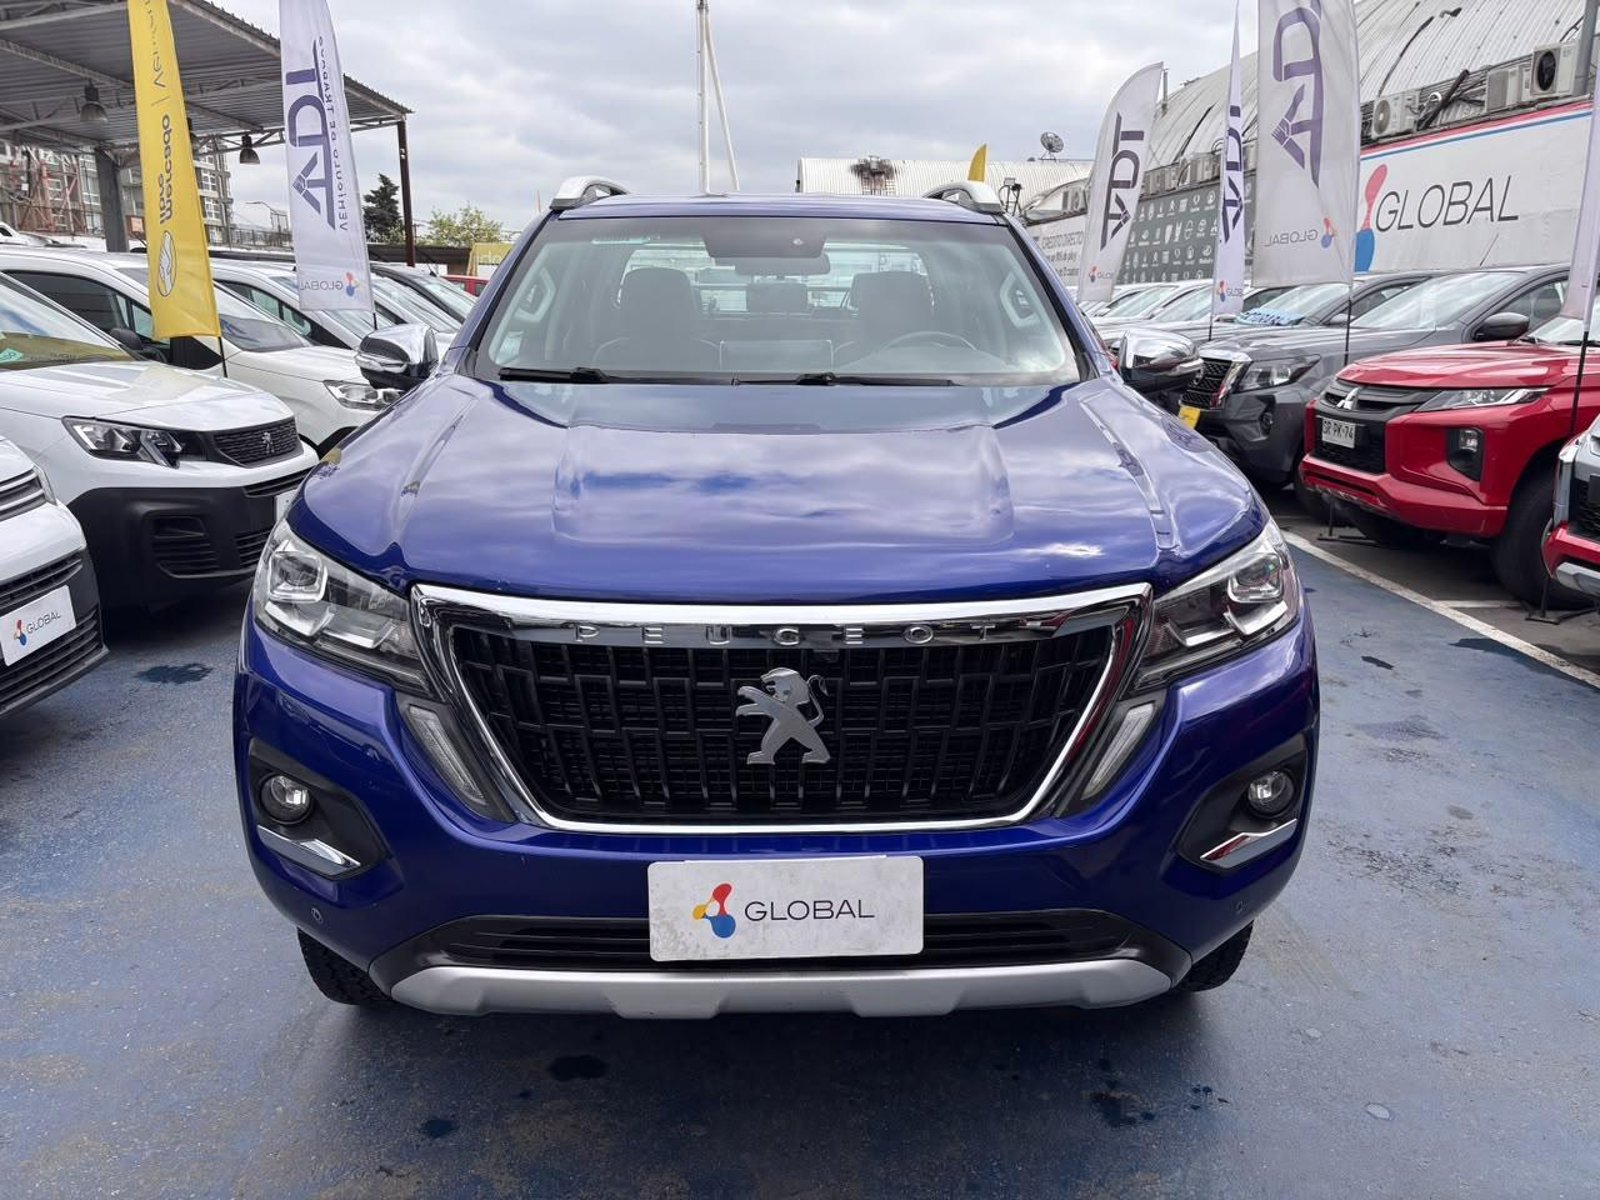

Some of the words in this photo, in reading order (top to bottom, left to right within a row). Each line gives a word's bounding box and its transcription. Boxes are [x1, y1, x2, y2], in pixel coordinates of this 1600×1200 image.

[1375, 175, 1519, 232] GLOBAL
[26, 610, 62, 634] GLOBAL
[574, 623, 997, 646] PEUGEOT
[744, 899, 875, 921] GLOBAL
